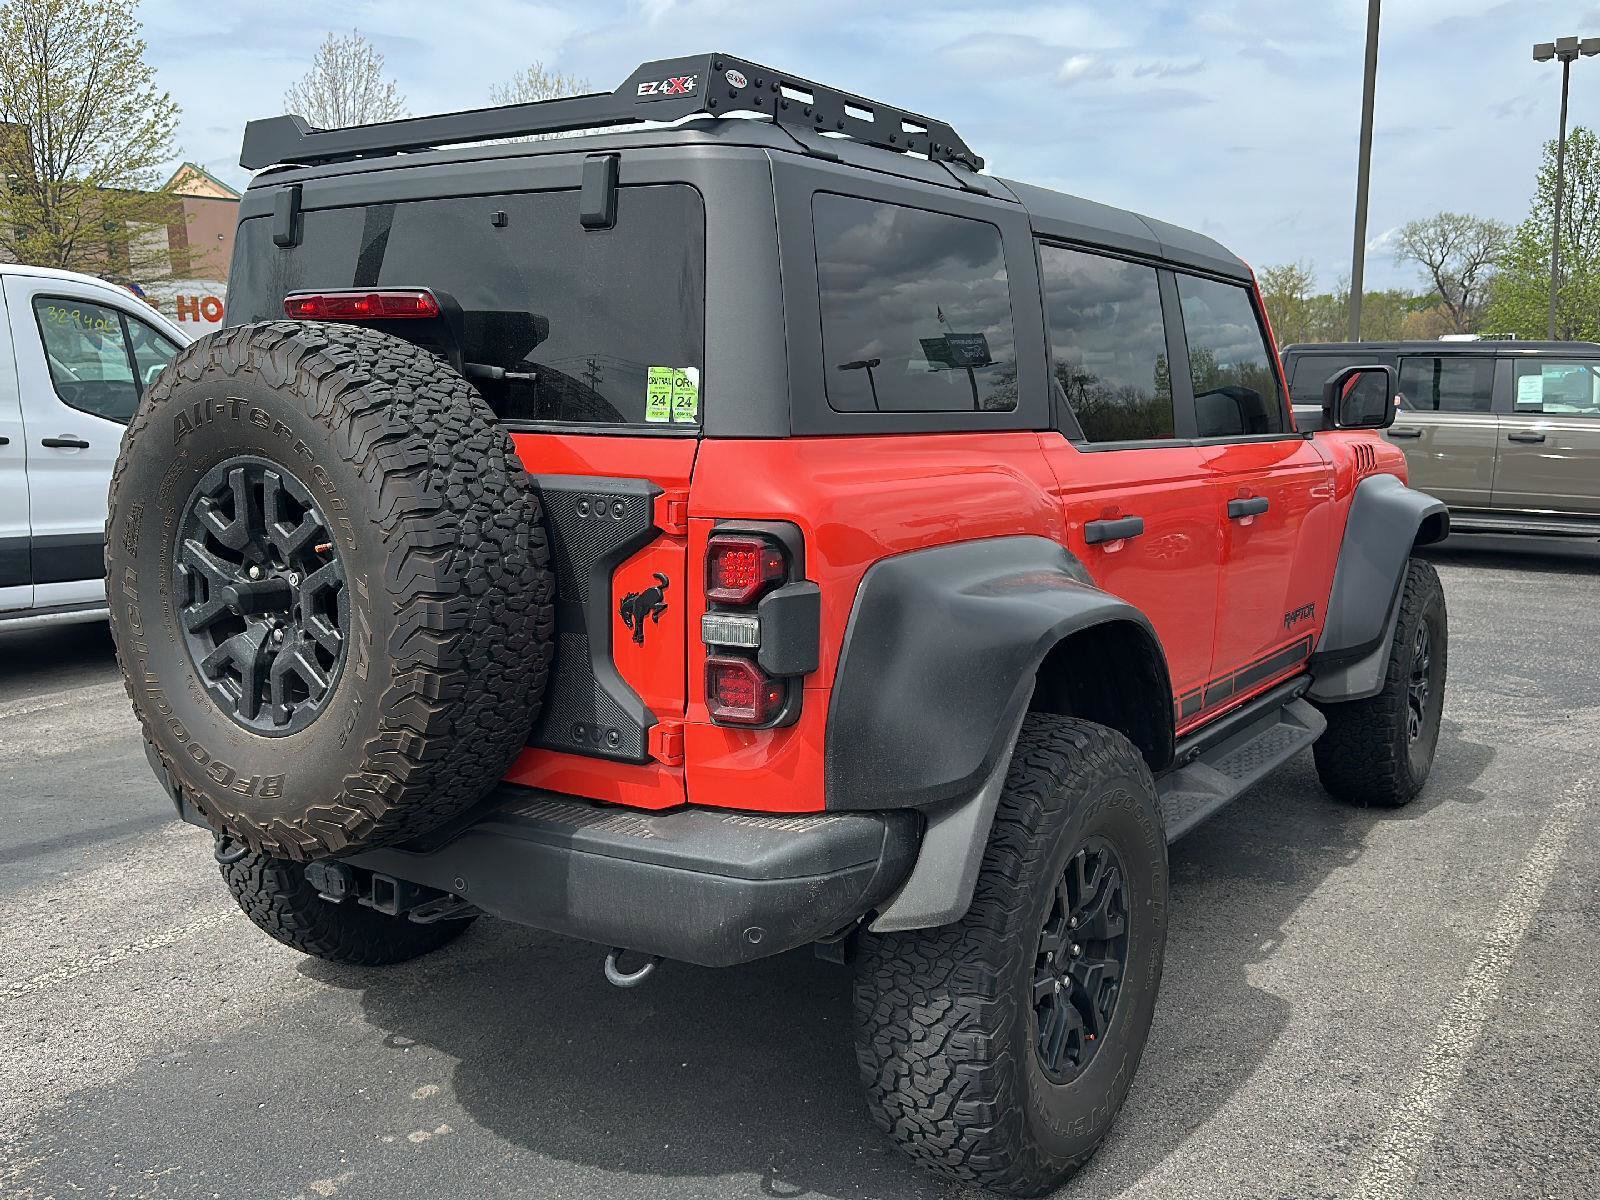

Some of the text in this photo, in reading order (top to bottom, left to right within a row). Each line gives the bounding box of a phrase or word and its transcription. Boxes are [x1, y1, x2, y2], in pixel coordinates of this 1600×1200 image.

[637, 76, 696, 97] EZ4X4
[675, 378, 692, 388] OR
[651, 395, 666, 406] 24
[676, 396, 692, 408] 24
[173, 396, 357, 551] All-Terrain
[1283, 601, 1316, 630] RAPTOR
[121, 565, 286, 800] BFGoodrich
